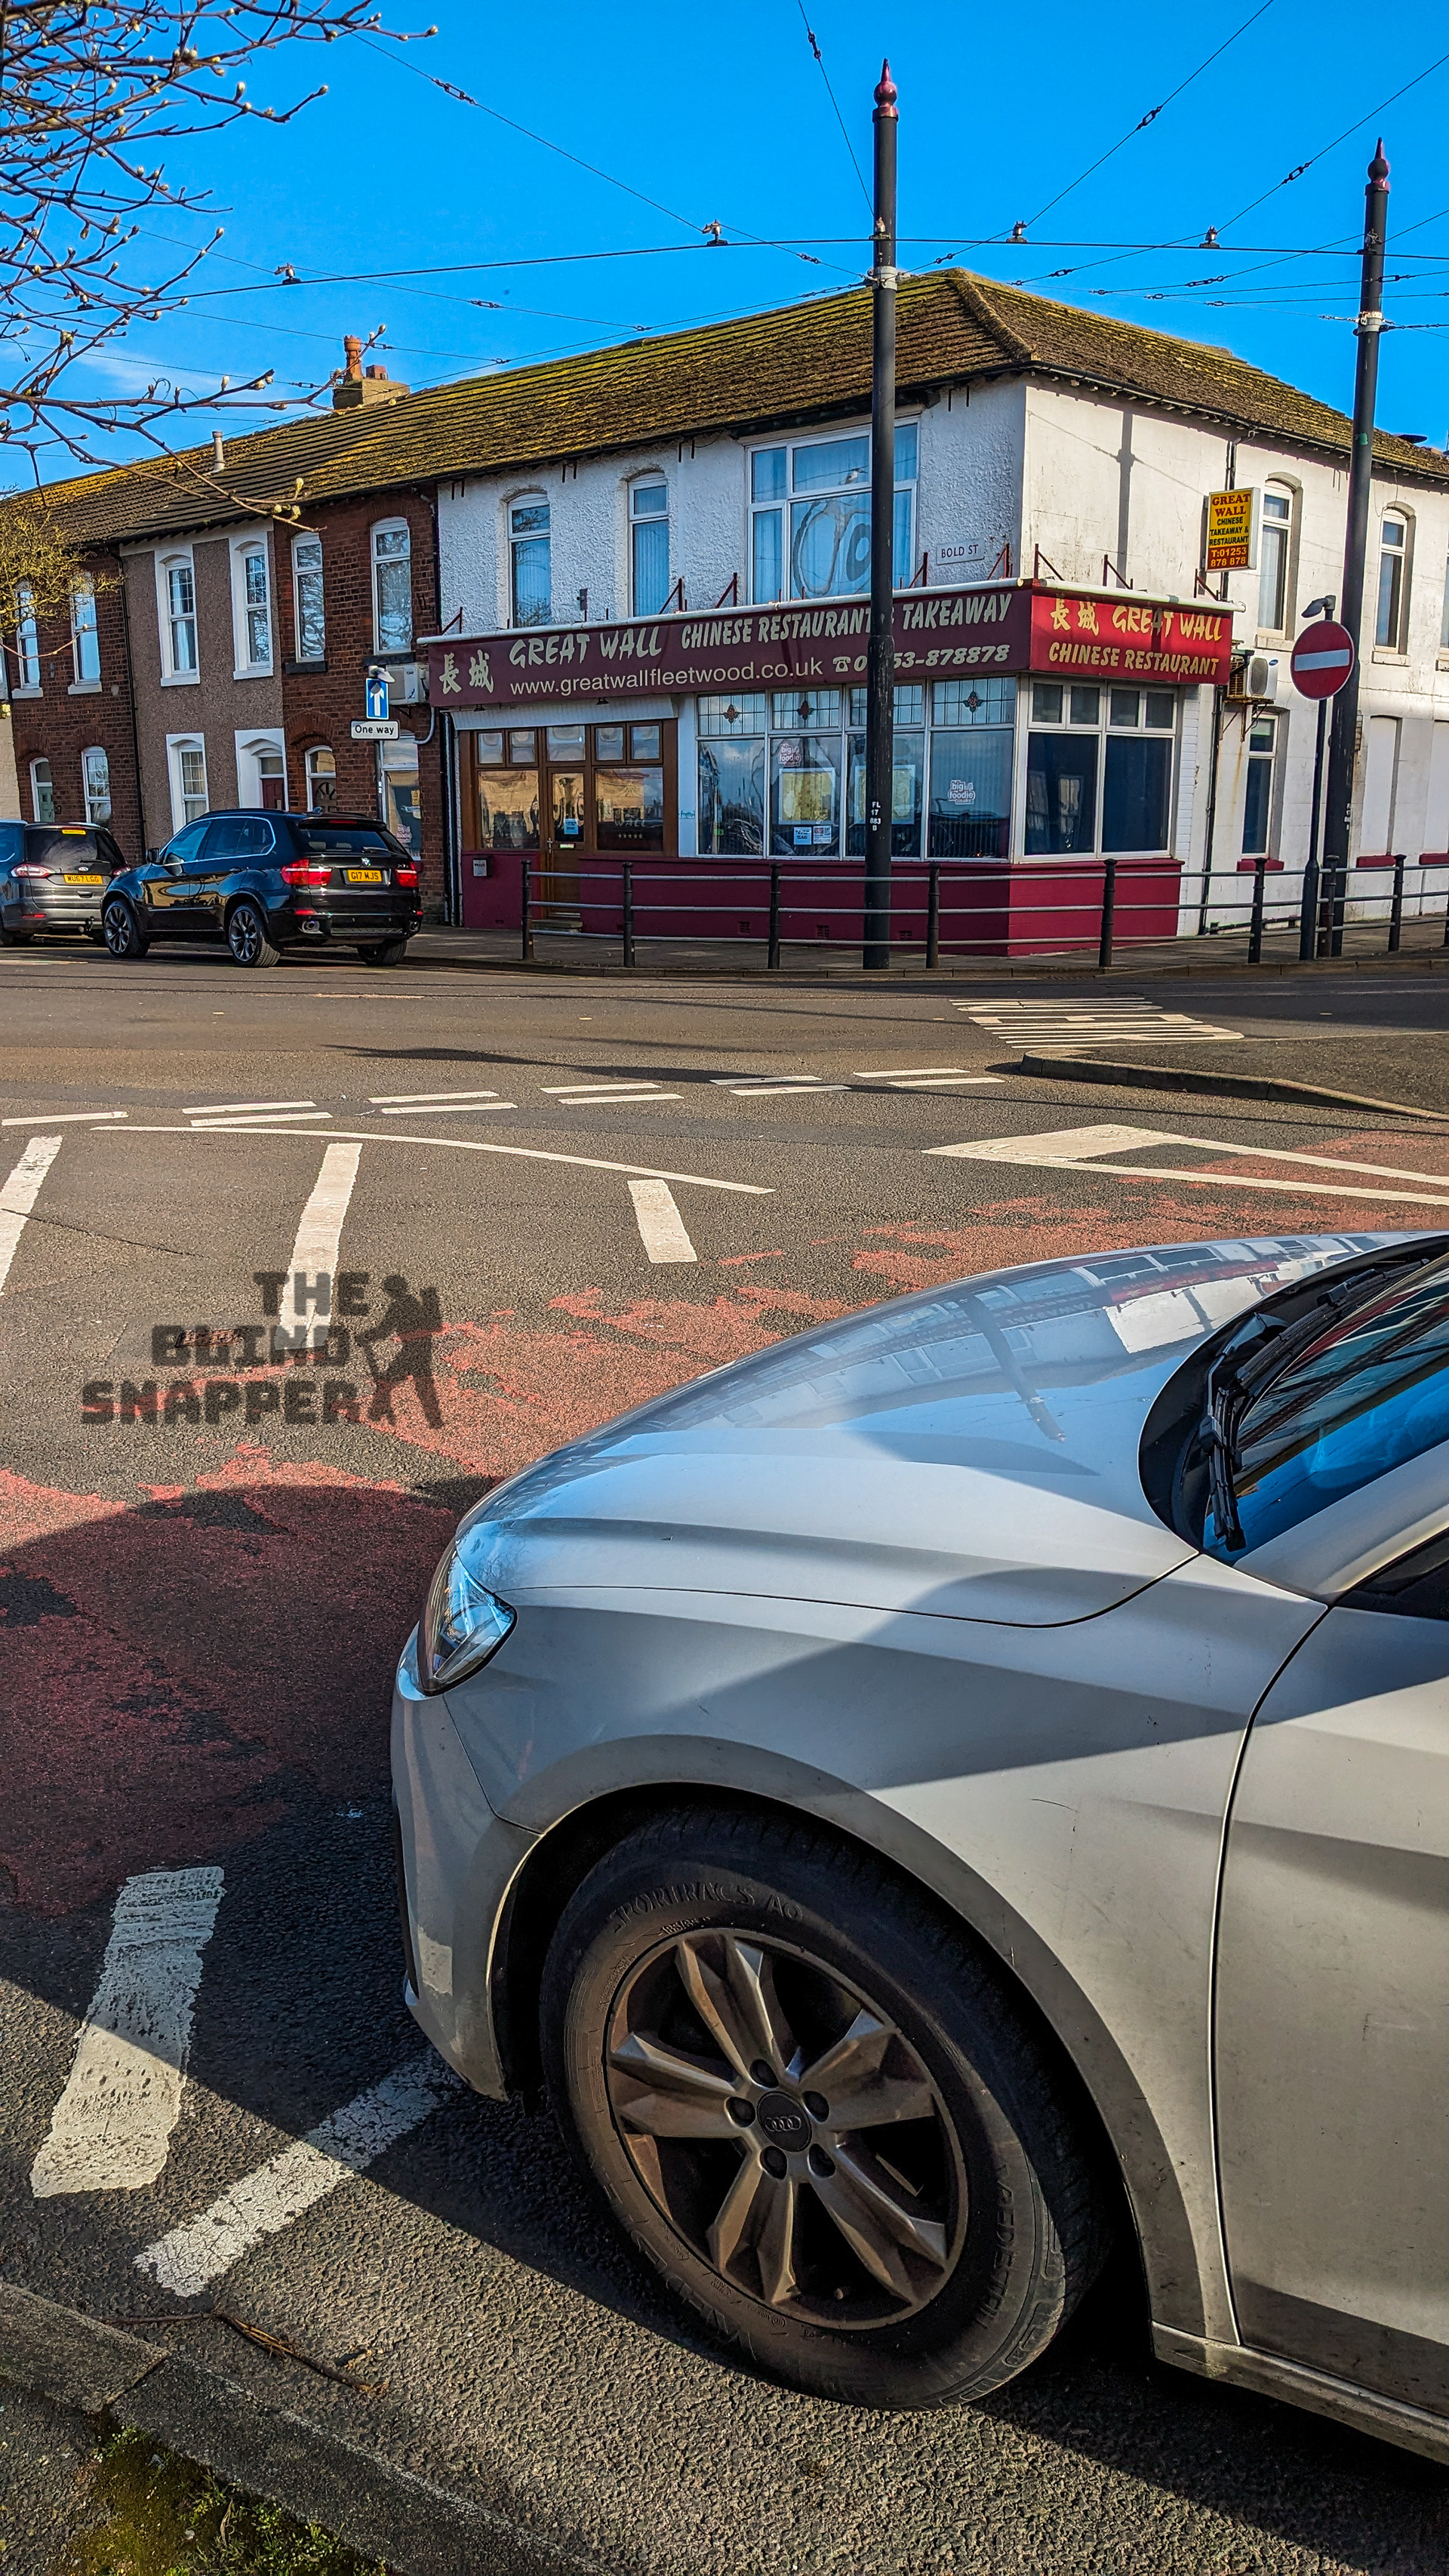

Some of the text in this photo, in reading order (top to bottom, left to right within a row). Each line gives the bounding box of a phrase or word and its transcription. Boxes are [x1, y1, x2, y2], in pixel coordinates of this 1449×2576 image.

[1212, 493, 1251, 506] GREAT
[1215, 506, 1246, 517] WALL
[1217, 516, 1243, 526] CHINESE
[1210, 526, 1243, 537] TAKEAWAY
[1209, 535, 1248, 546] RESTAURANT
[941, 544, 979, 559] BOLD ST
[1211, 546, 1247, 558] T:01253
[1211, 556, 1246, 567] 878 878
[1112, 604, 1223, 642] GREAT WALL
[509, 633, 590, 669] GREAT
[600, 626, 663, 660] WALL
[681, 618, 752, 650] CHINESE
[903, 593, 1012, 631] TAKEAWAY
[1048, 642, 1220, 676] CHINESE RESTAURANT
[509, 645, 1011, 697] www.greatwallfleetwood.co.uk 053-878878
[355, 725, 394, 735] One way
[952, 782, 964, 792] big
[949, 790, 974, 799] foodie
